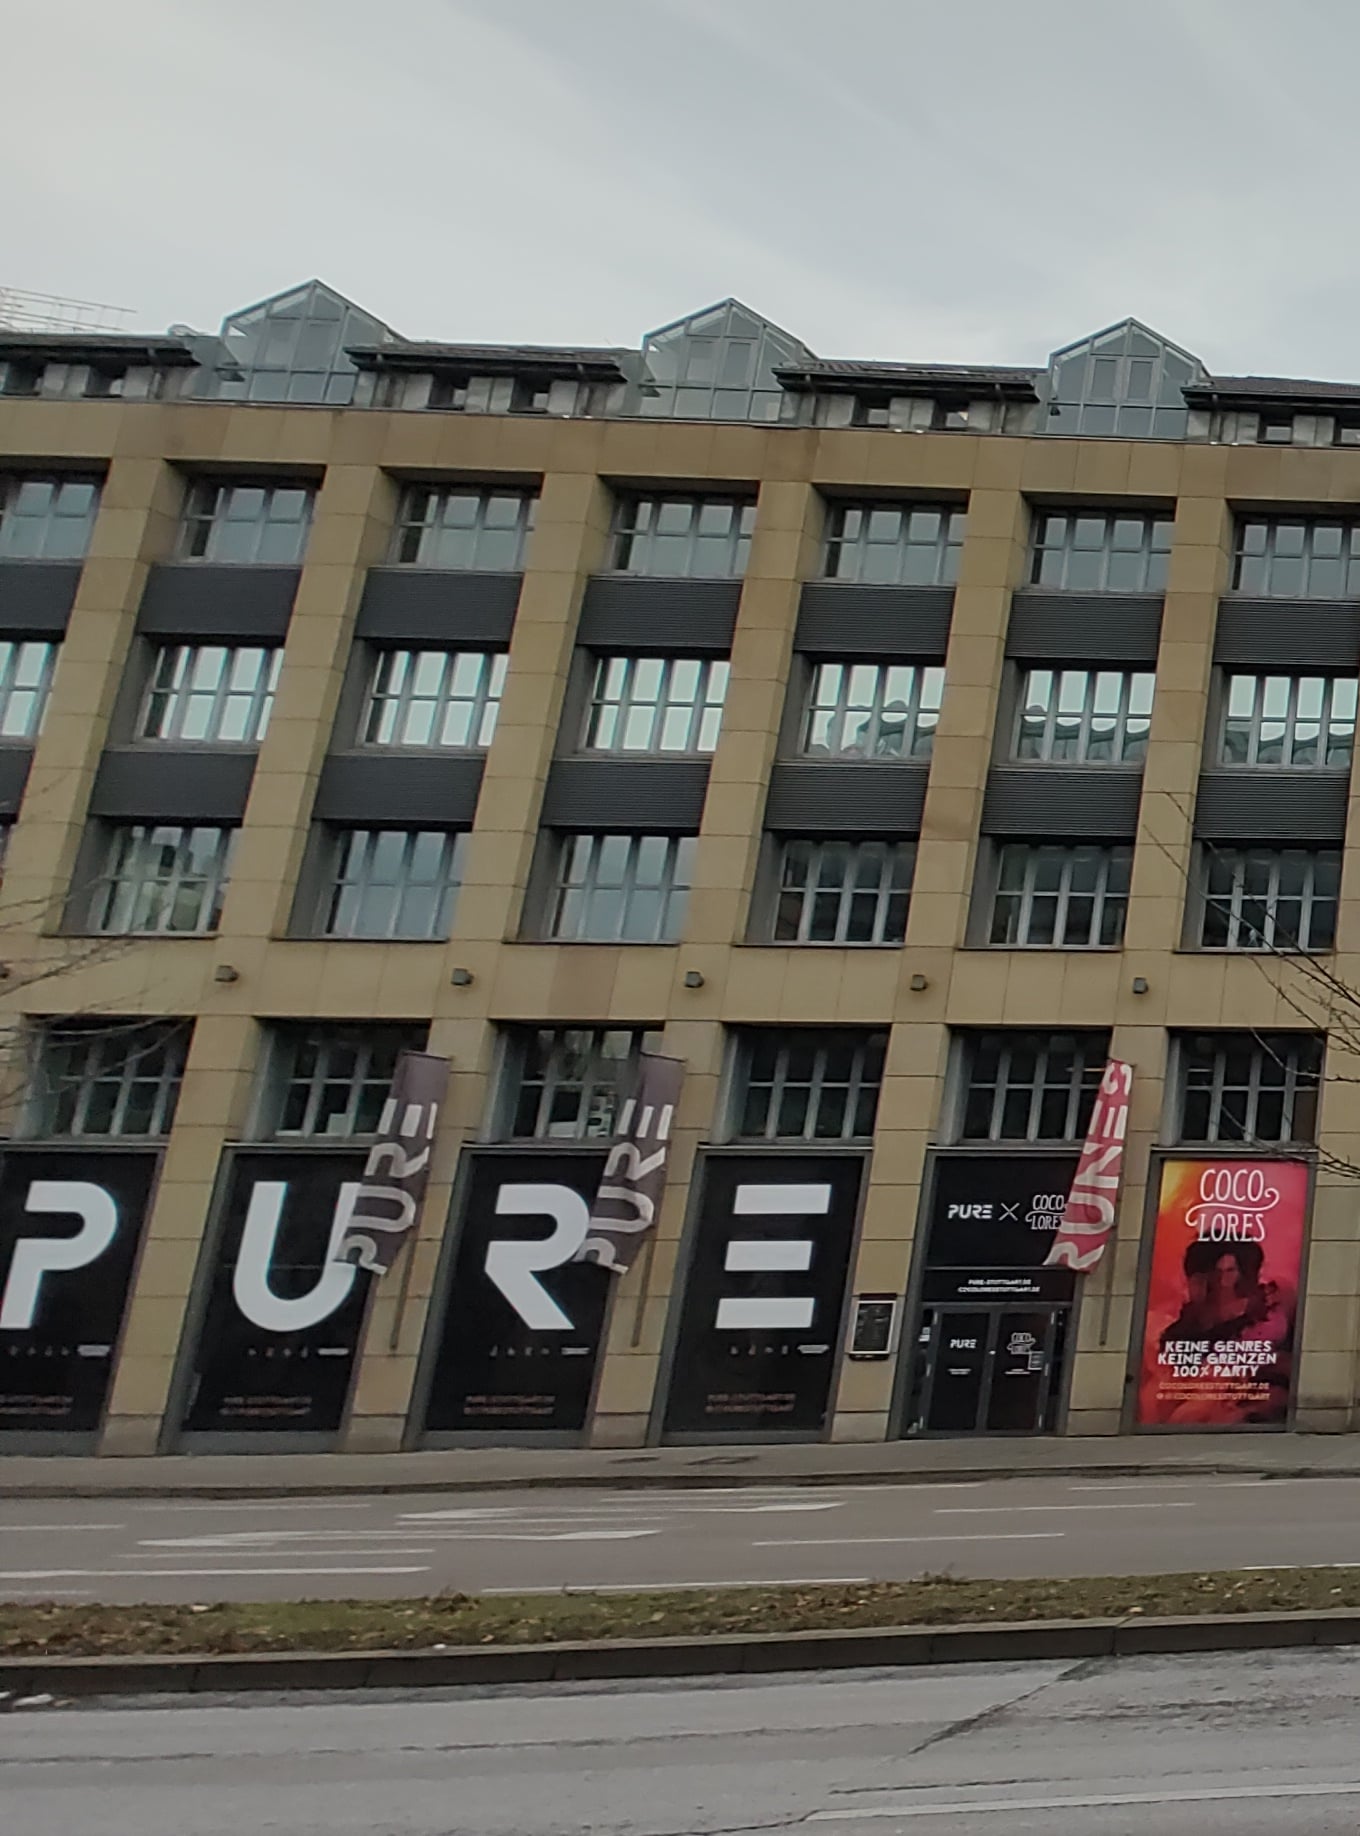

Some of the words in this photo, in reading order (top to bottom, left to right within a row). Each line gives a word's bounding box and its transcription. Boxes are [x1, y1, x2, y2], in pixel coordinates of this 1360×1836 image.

[333, 1099, 437, 1275] PURE
[572, 1099, 673, 1274] PURE
[1200, 1168, 1264, 1202] COCO
[948, 1204, 993, 1219] PURE
[1197, 1213, 1266, 1242] LORES
[950, 1339, 977, 1349] PURE
[1165, 1340, 1209, 1353] KEINE
[1214, 1340, 1272, 1353] GENRES
[1158, 1353, 1202, 1365] KEINE
[1206, 1353, 1277, 1365] GRENZEN
[1172, 1365, 1209, 1378] 100%
[1213, 1365, 1260, 1377] PARTY
